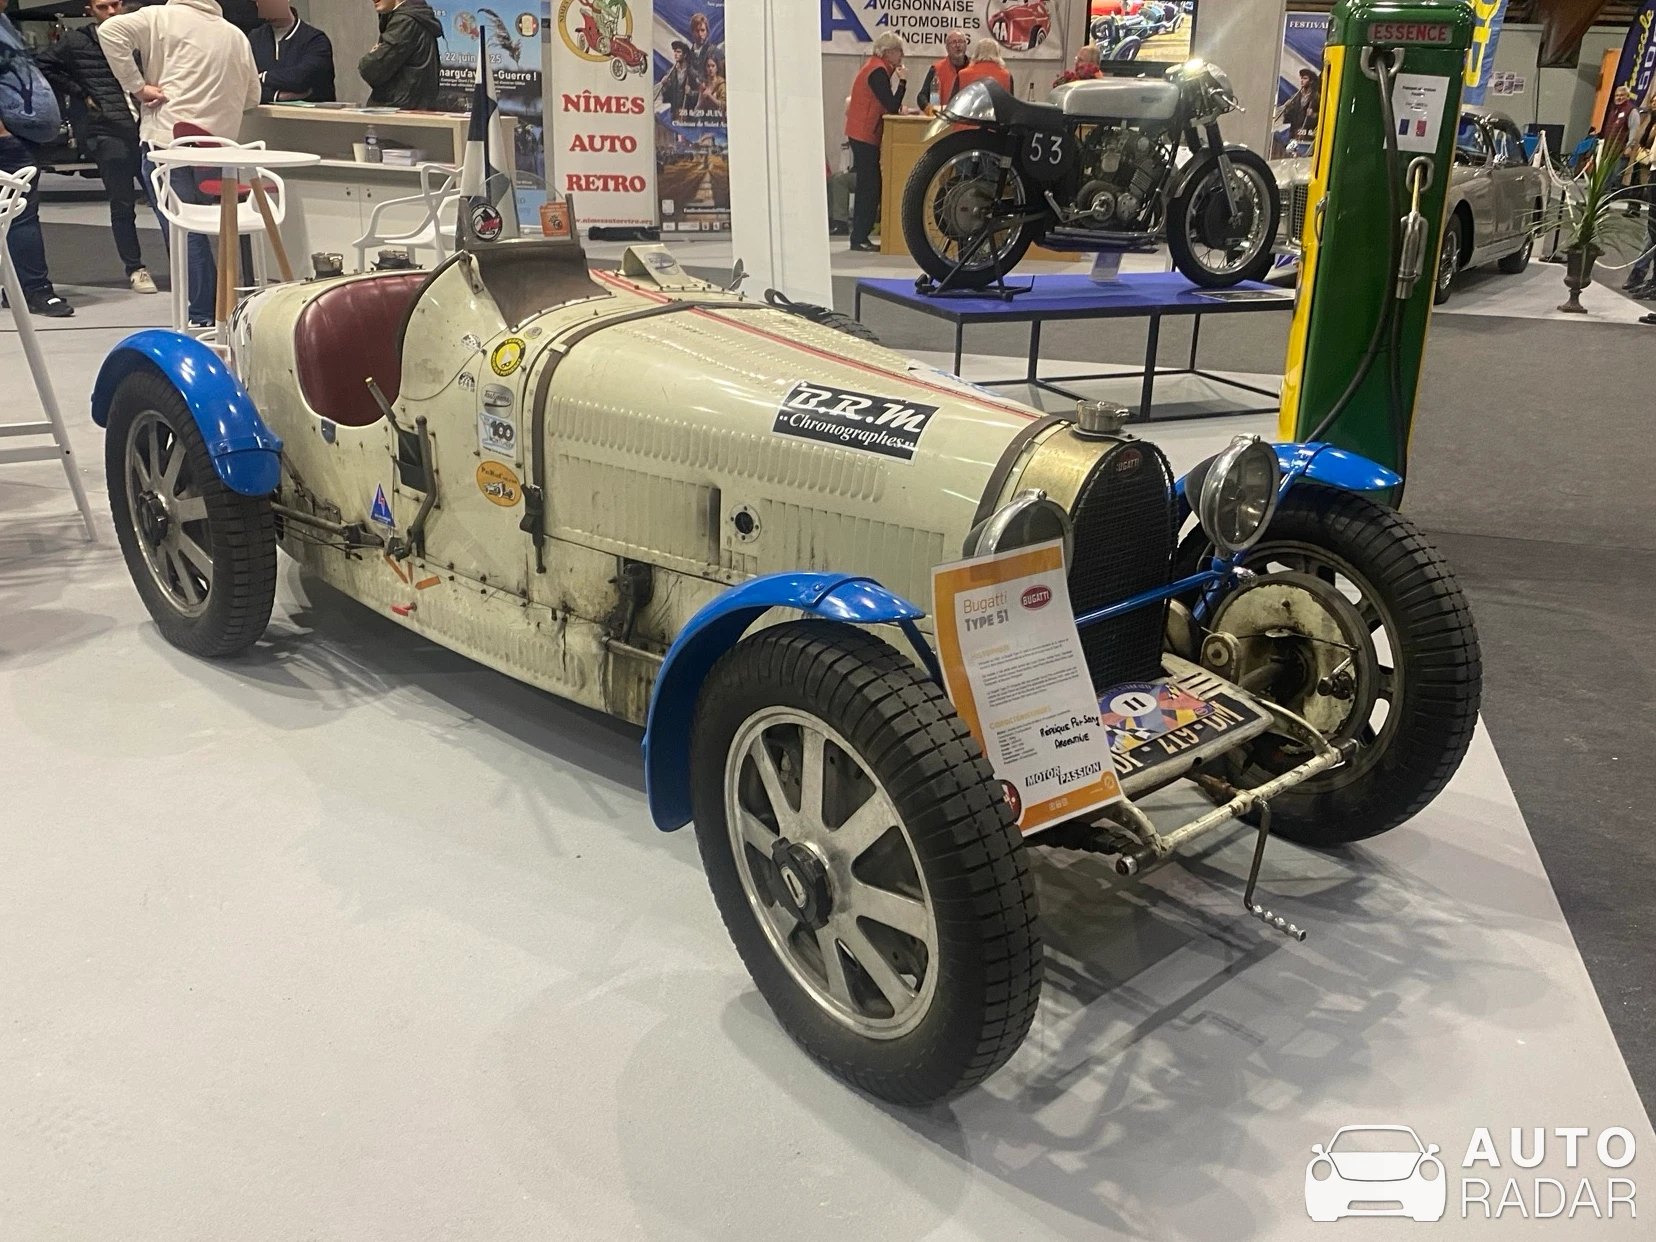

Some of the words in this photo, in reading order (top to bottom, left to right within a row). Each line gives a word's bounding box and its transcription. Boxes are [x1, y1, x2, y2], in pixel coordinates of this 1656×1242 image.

[864, 0, 974, 12] AVIGNONNAISE
[876, 13, 980, 29] AUTOMOBILES
[1374, 24, 1448, 41] ESSENCE
[562, 89, 645, 114] NÎMES
[569, 134, 637, 153] AUTO
[1030, 133, 1062, 164] 53
[566, 174, 647, 193] RETRO
[490, 420, 514, 441] 100
[963, 590, 1008, 614] Bugatti
[1022, 590, 1050, 606] BUGATTI
[996, 608, 1010, 624] 51
[1025, 765, 1061, 788] MOTOR
[1058, 761, 1102, 785] PASSION
